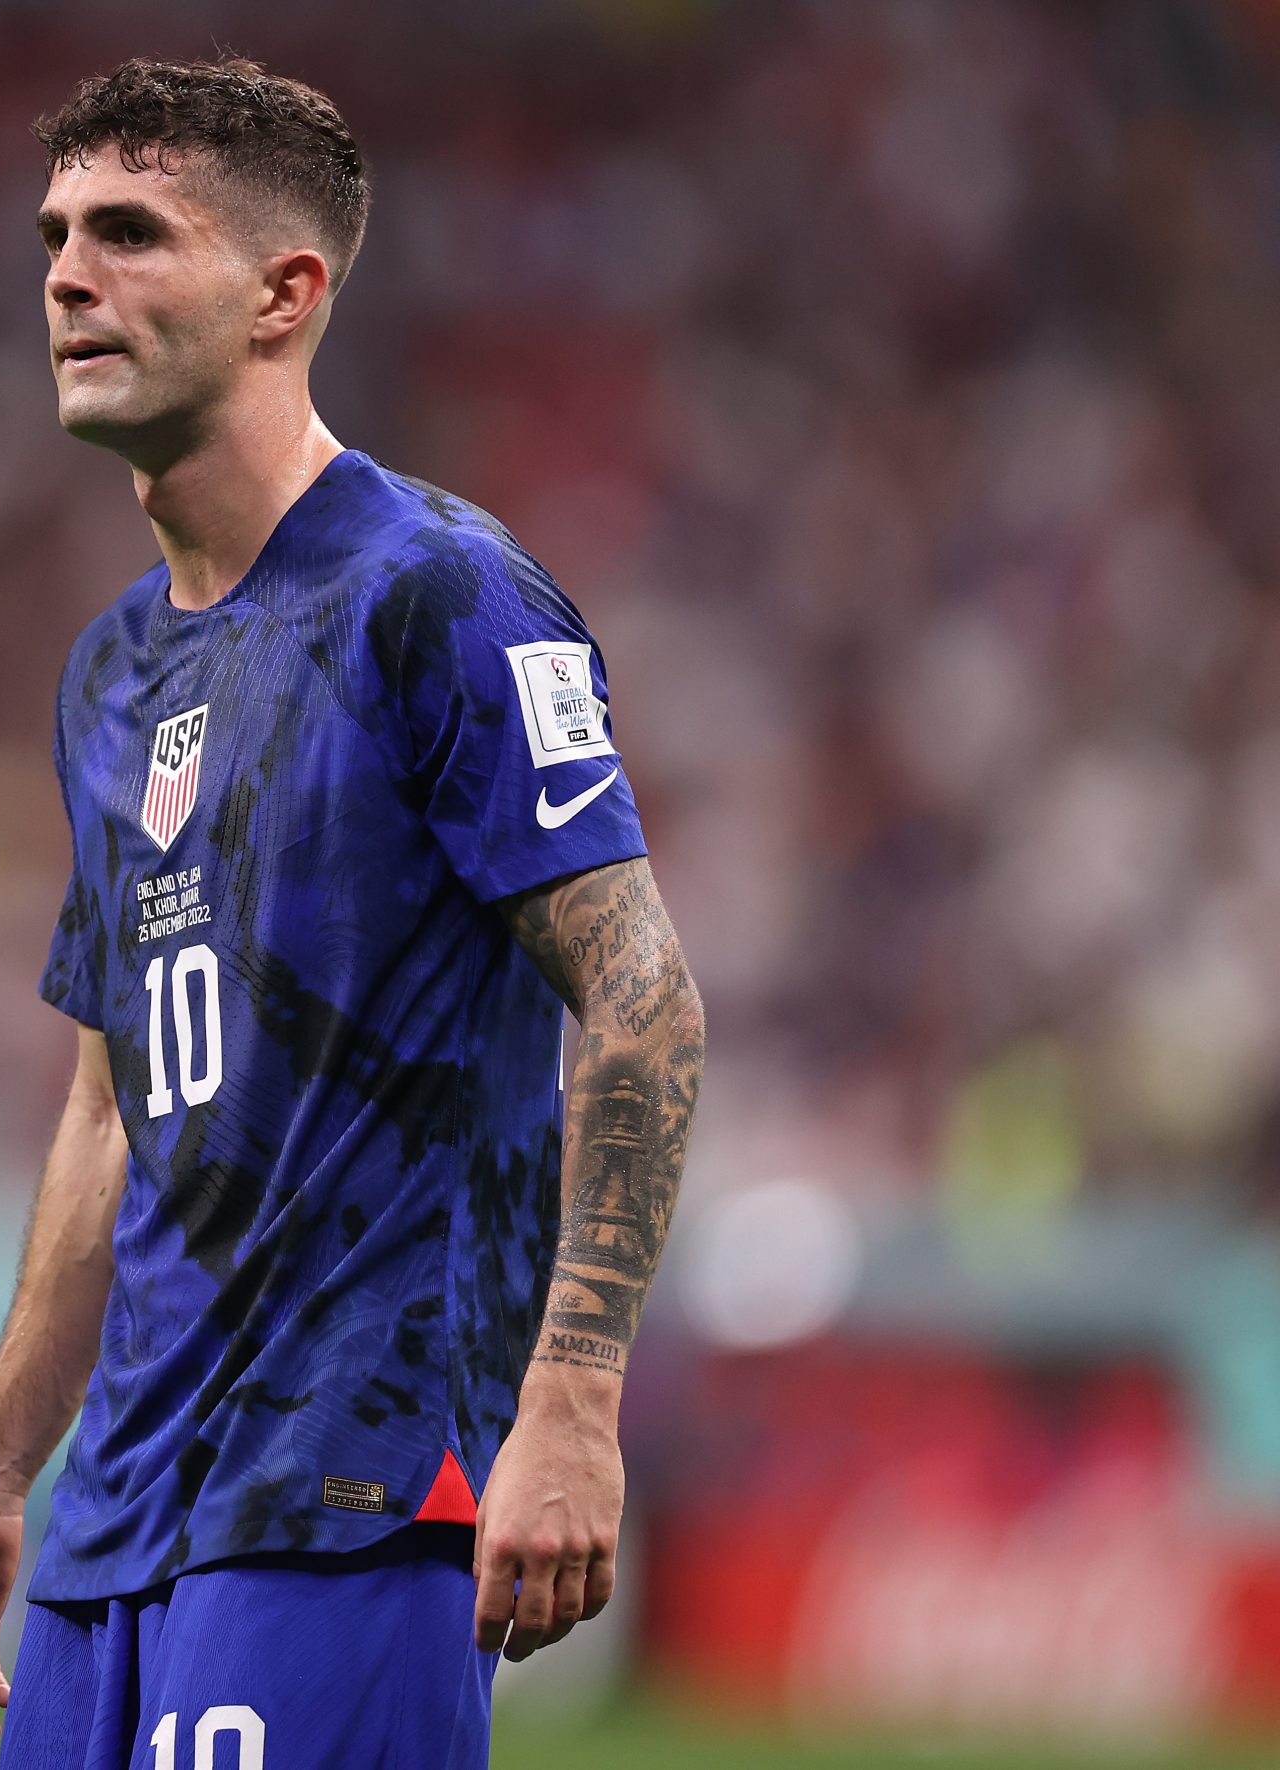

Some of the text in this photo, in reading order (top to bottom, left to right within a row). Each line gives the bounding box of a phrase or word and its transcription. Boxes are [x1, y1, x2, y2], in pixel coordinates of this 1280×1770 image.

[551, 688, 586, 701] FOOTBALL
[157, 712, 205, 772] USA
[570, 731, 587, 741] FIFA
[137, 865, 201, 901] ENGLAND VS. USA
[142, 886, 200, 921] AL KHOR, QATAR
[138, 904, 212, 943] 25 NOVEMBER 2022
[145, 943, 223, 1119] 10
